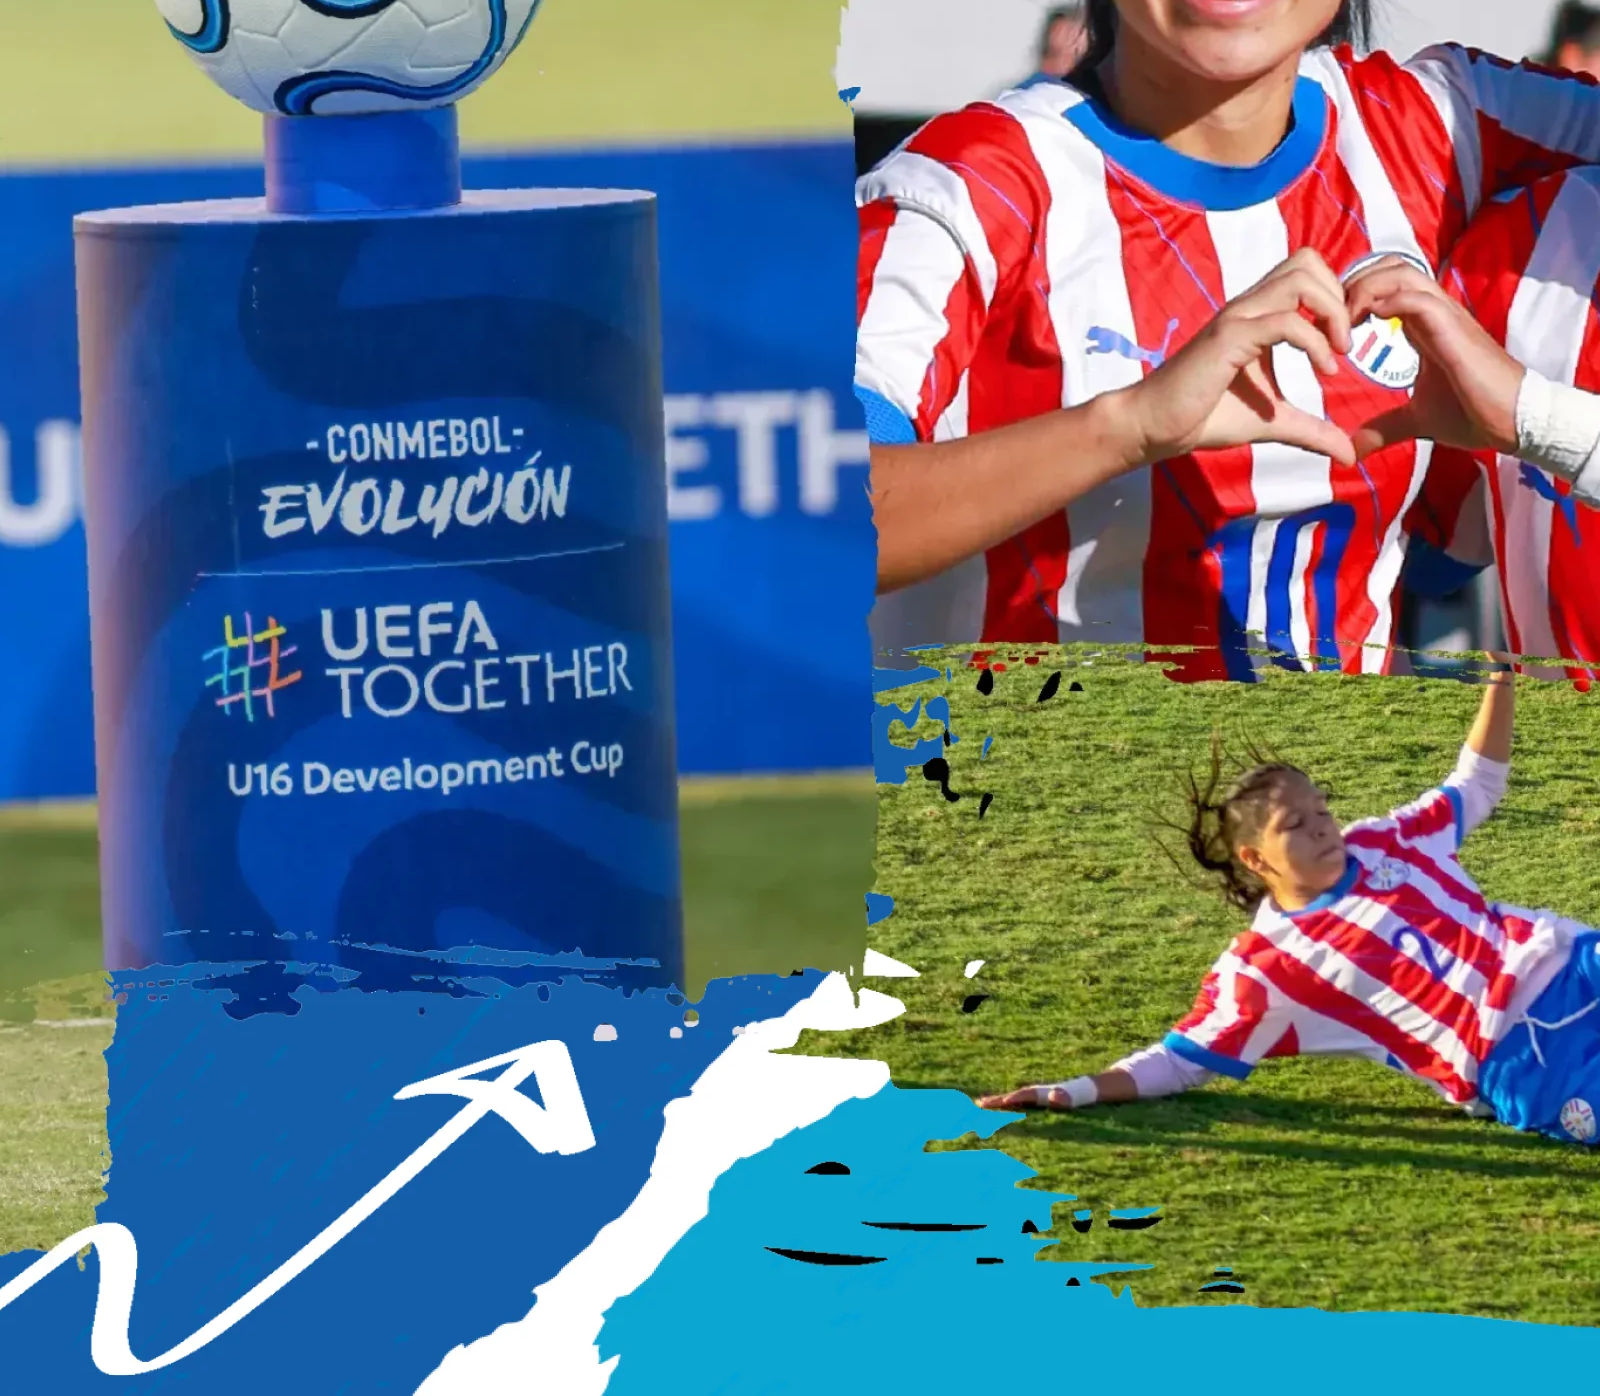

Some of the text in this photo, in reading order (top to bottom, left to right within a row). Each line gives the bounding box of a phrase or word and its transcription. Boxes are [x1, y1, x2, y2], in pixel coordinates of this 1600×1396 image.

[258, 450, 571, 539] EVOLUCIÓN
[1206, 501, 1357, 684] 10
[321, 600, 499, 661] UEFA
[325, 642, 633, 719] TOGETHER
[228, 740, 624, 796] U16 Development Cup
[1392, 926, 1455, 982] 2
